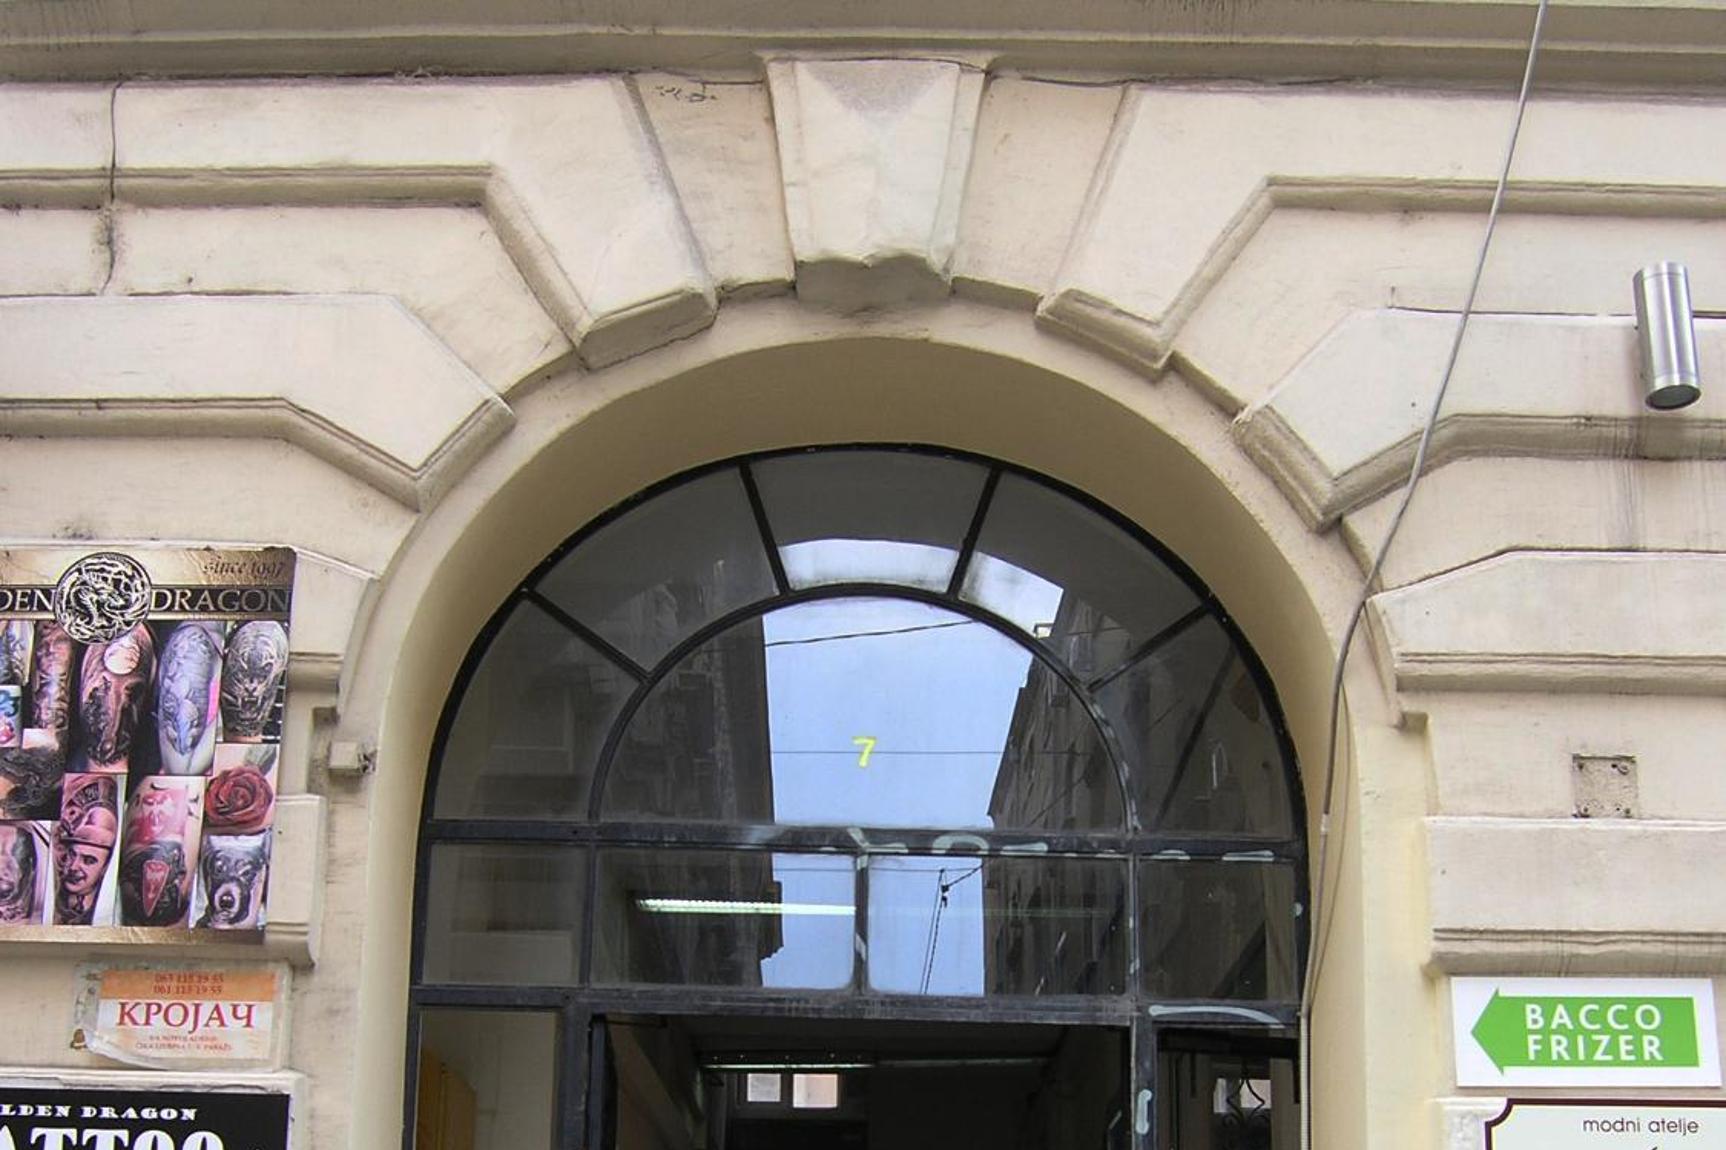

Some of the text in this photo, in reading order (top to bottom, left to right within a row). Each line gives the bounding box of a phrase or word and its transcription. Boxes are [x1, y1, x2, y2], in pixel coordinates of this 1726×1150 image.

[151, 588, 290, 612] DRAGON
[851, 735, 877, 768] 7
[116, 1001, 257, 1034] КРОЈАЧ
[1525, 1003, 1662, 1030] BACCO
[1528, 1035, 1664, 1061] FRIZER
[81, 1105, 198, 1121] DRAGON
[1583, 1117, 1700, 1136] modni atelje
